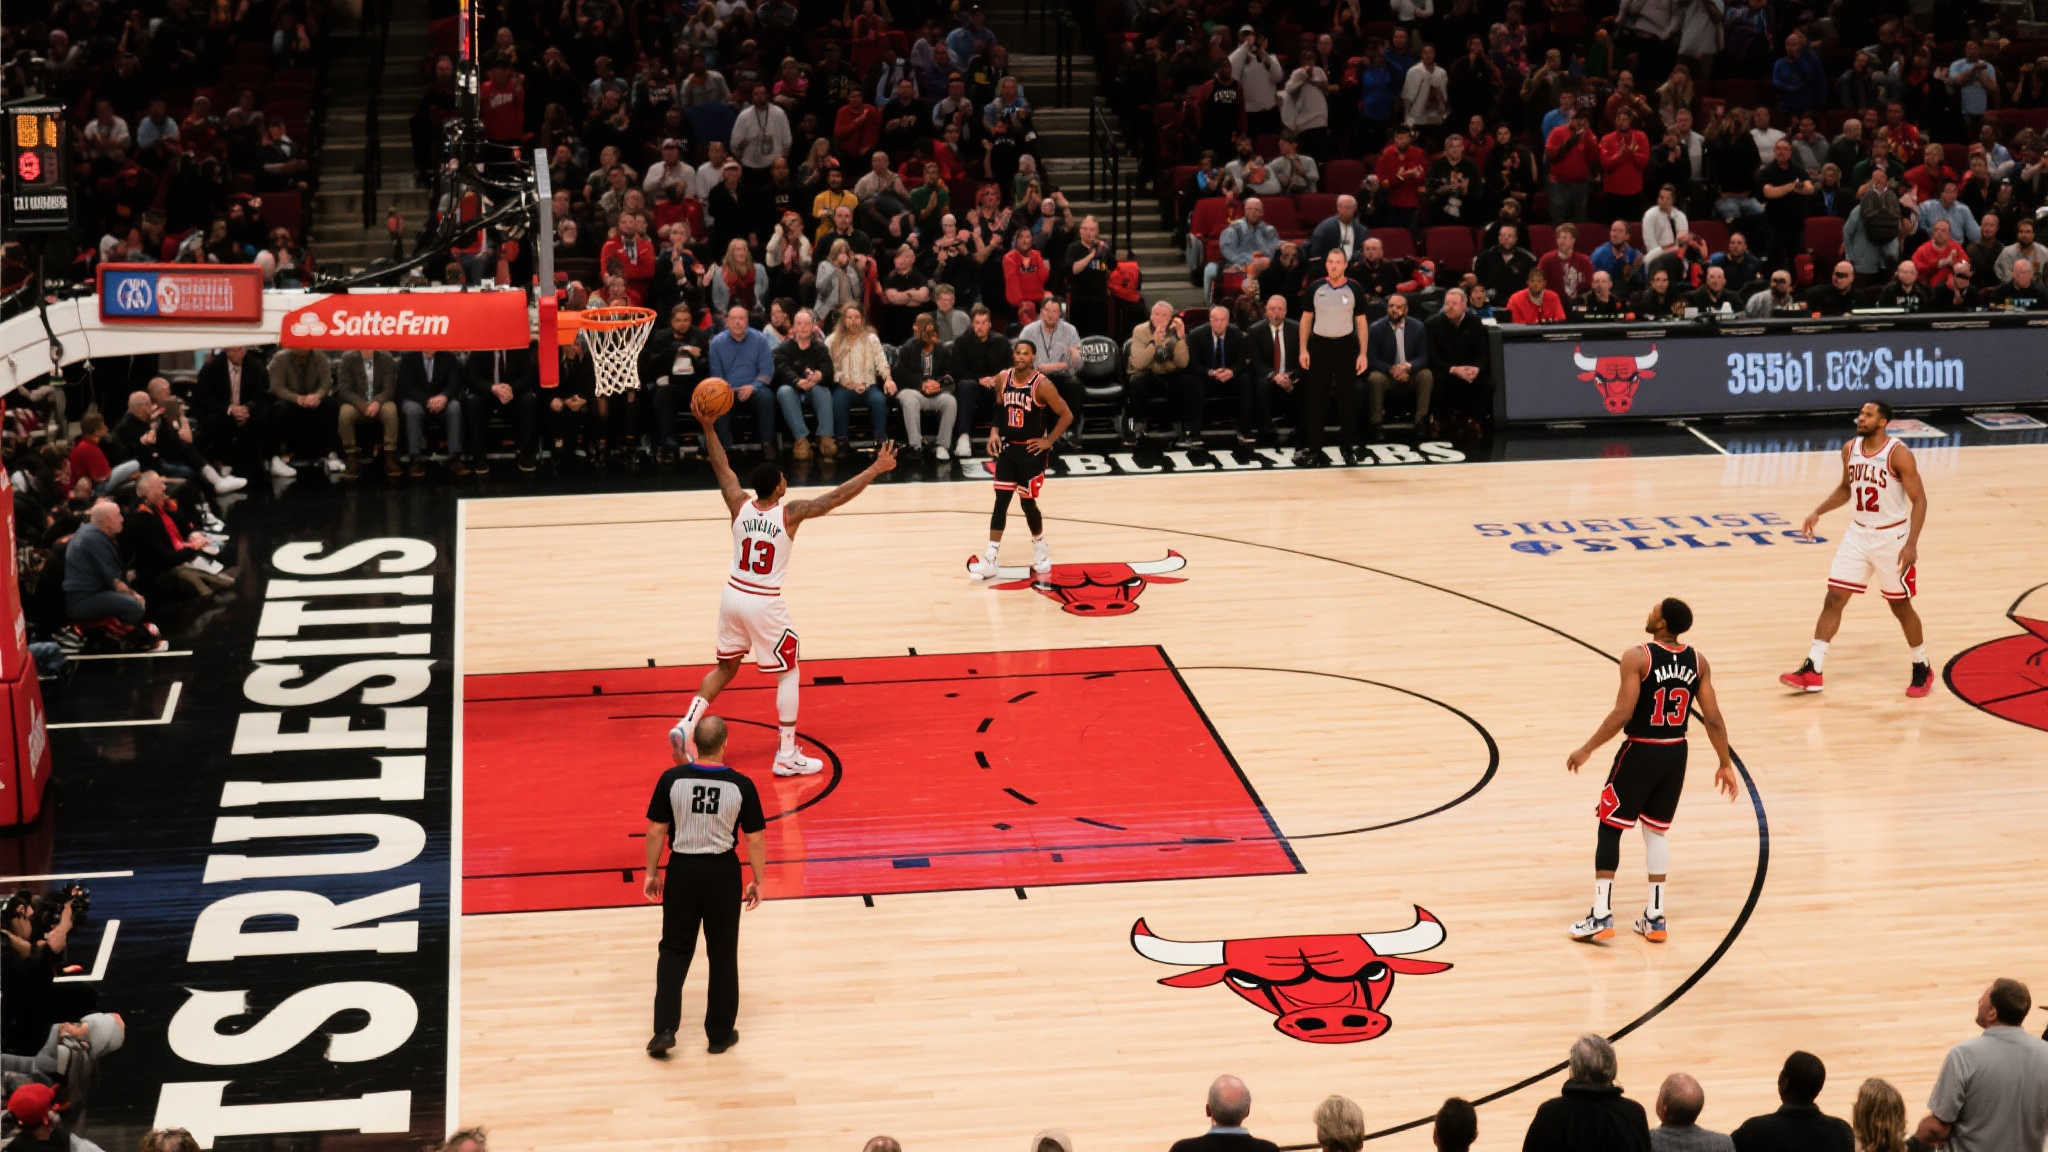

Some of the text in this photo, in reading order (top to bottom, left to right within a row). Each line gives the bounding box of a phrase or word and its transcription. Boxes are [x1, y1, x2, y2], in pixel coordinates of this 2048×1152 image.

[1847, 463, 1888, 490] BULLS
[1856, 486, 1880, 513] 12
[738, 537, 776, 575] 13
[1650, 686, 1691, 727] 13
